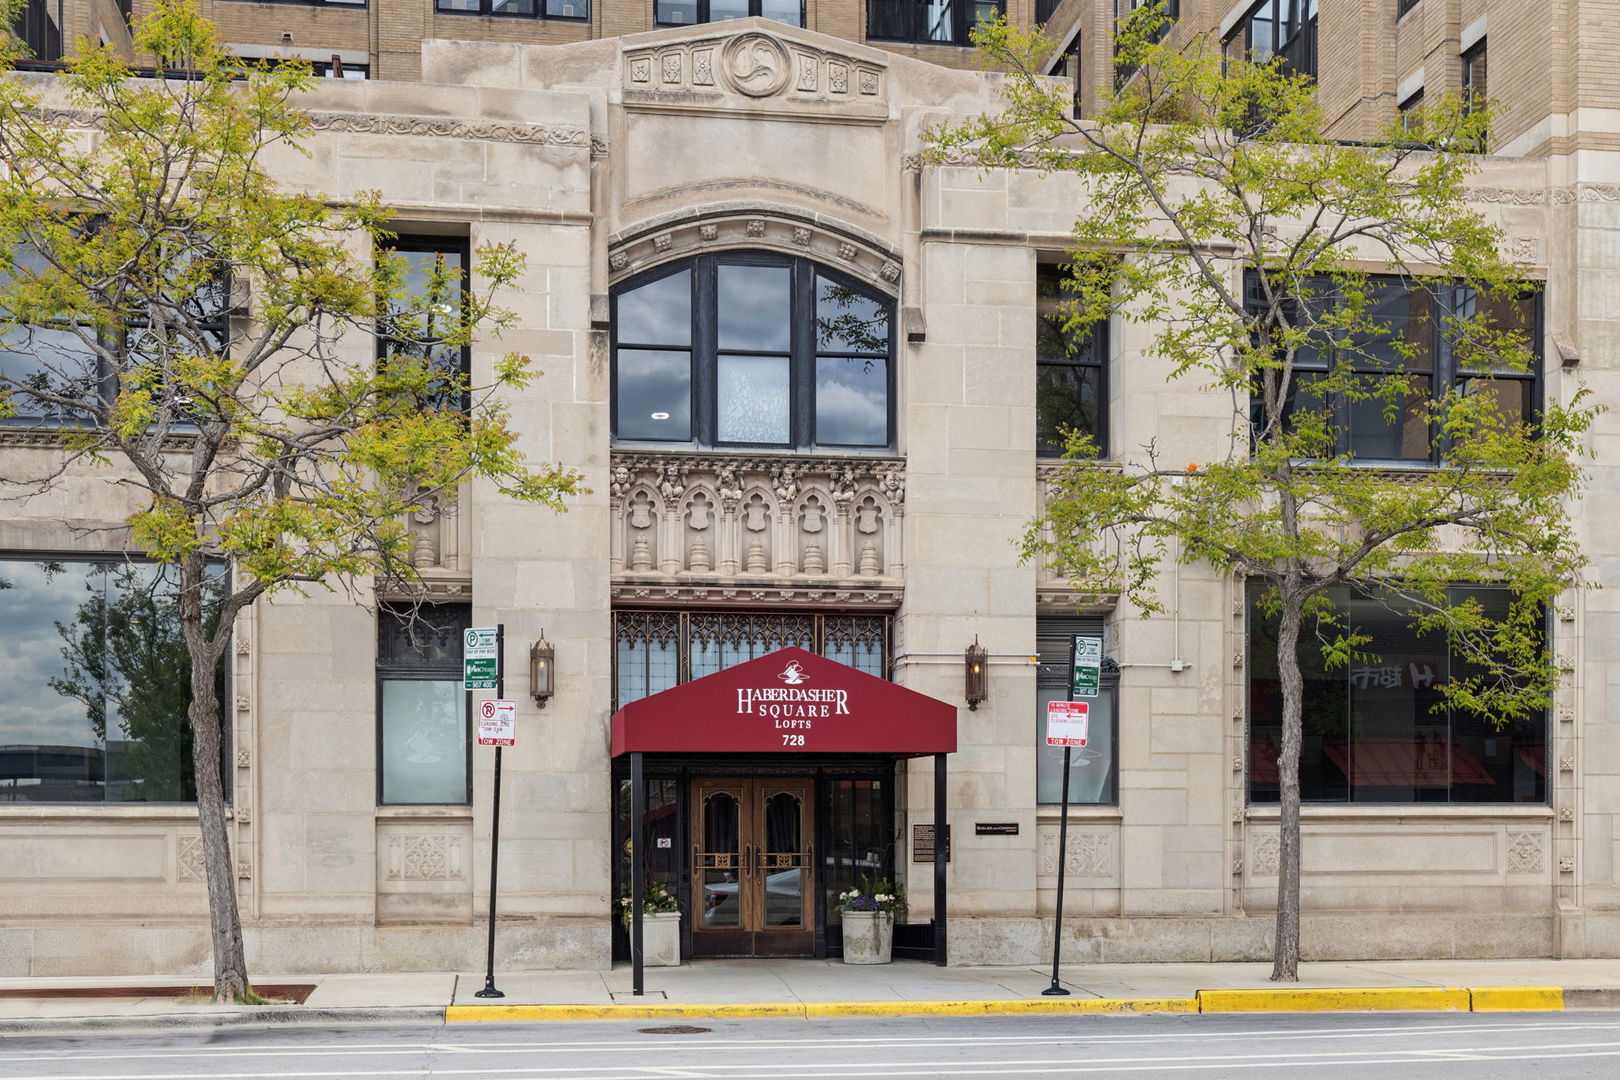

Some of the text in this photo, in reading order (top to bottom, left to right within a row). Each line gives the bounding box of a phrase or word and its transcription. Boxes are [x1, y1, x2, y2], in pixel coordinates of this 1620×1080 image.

[736, 688, 850, 714] HABERDASHER
[759, 704, 830, 718] SQUARE
[775, 720, 812, 729] LOFTS
[782, 735, 805, 746] 728
